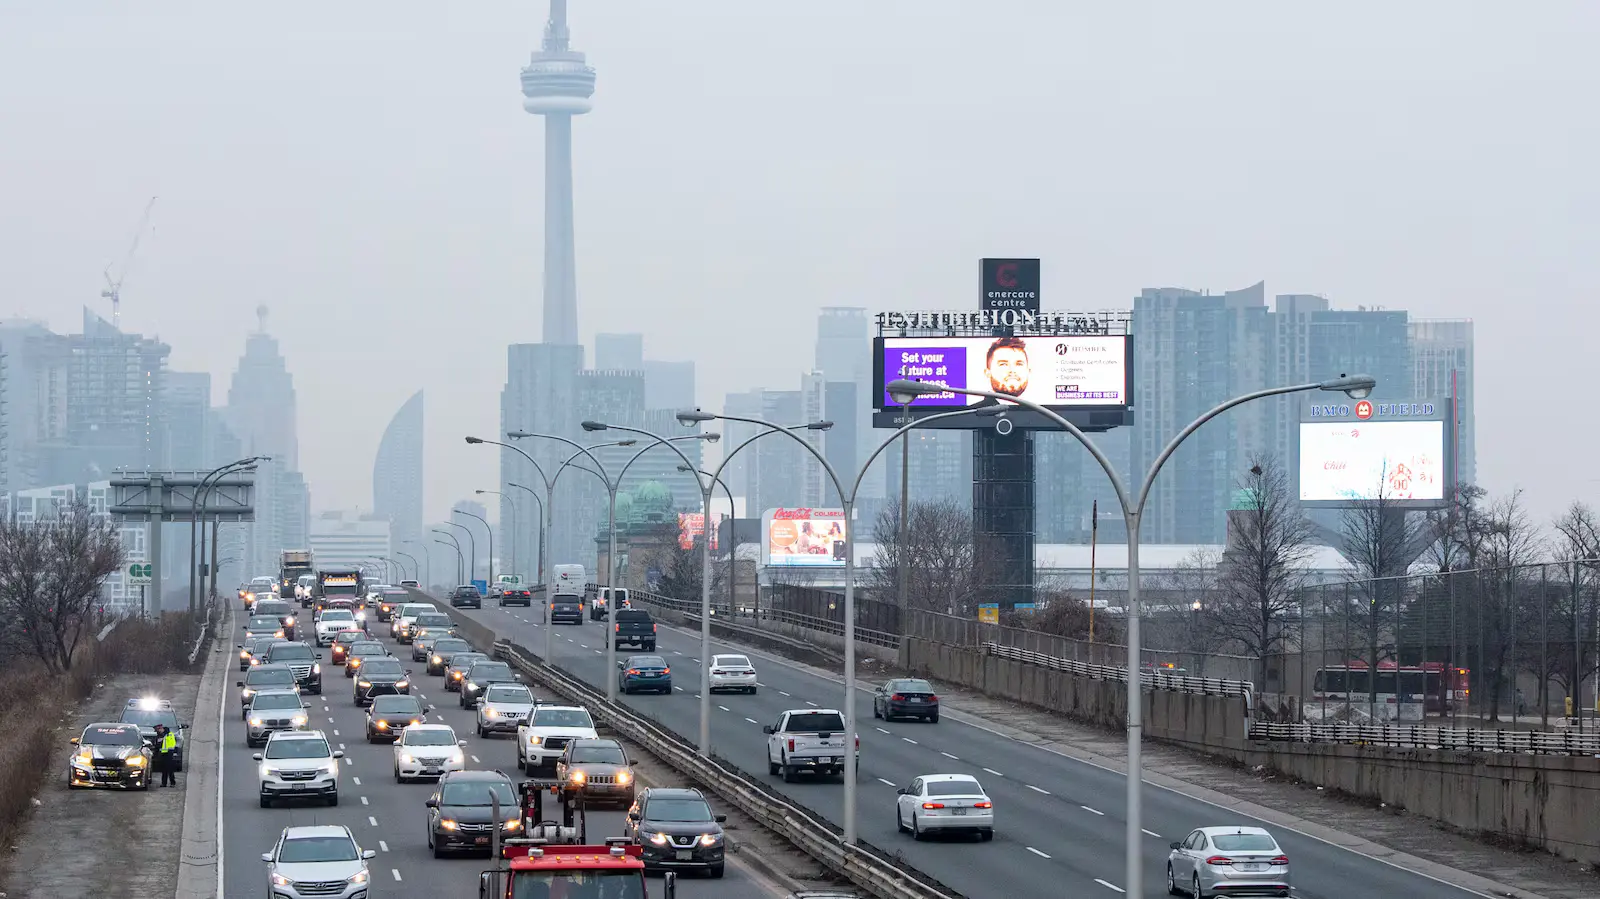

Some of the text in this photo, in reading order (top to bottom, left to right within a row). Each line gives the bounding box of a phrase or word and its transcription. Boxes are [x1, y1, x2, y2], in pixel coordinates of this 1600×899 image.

[988, 291, 1035, 299] enercare
[991, 299, 1026, 307] centre
[901, 352, 944, 365] Set your
[936, 365, 947, 376] at
[1311, 403, 1435, 417] BMO FIELD
